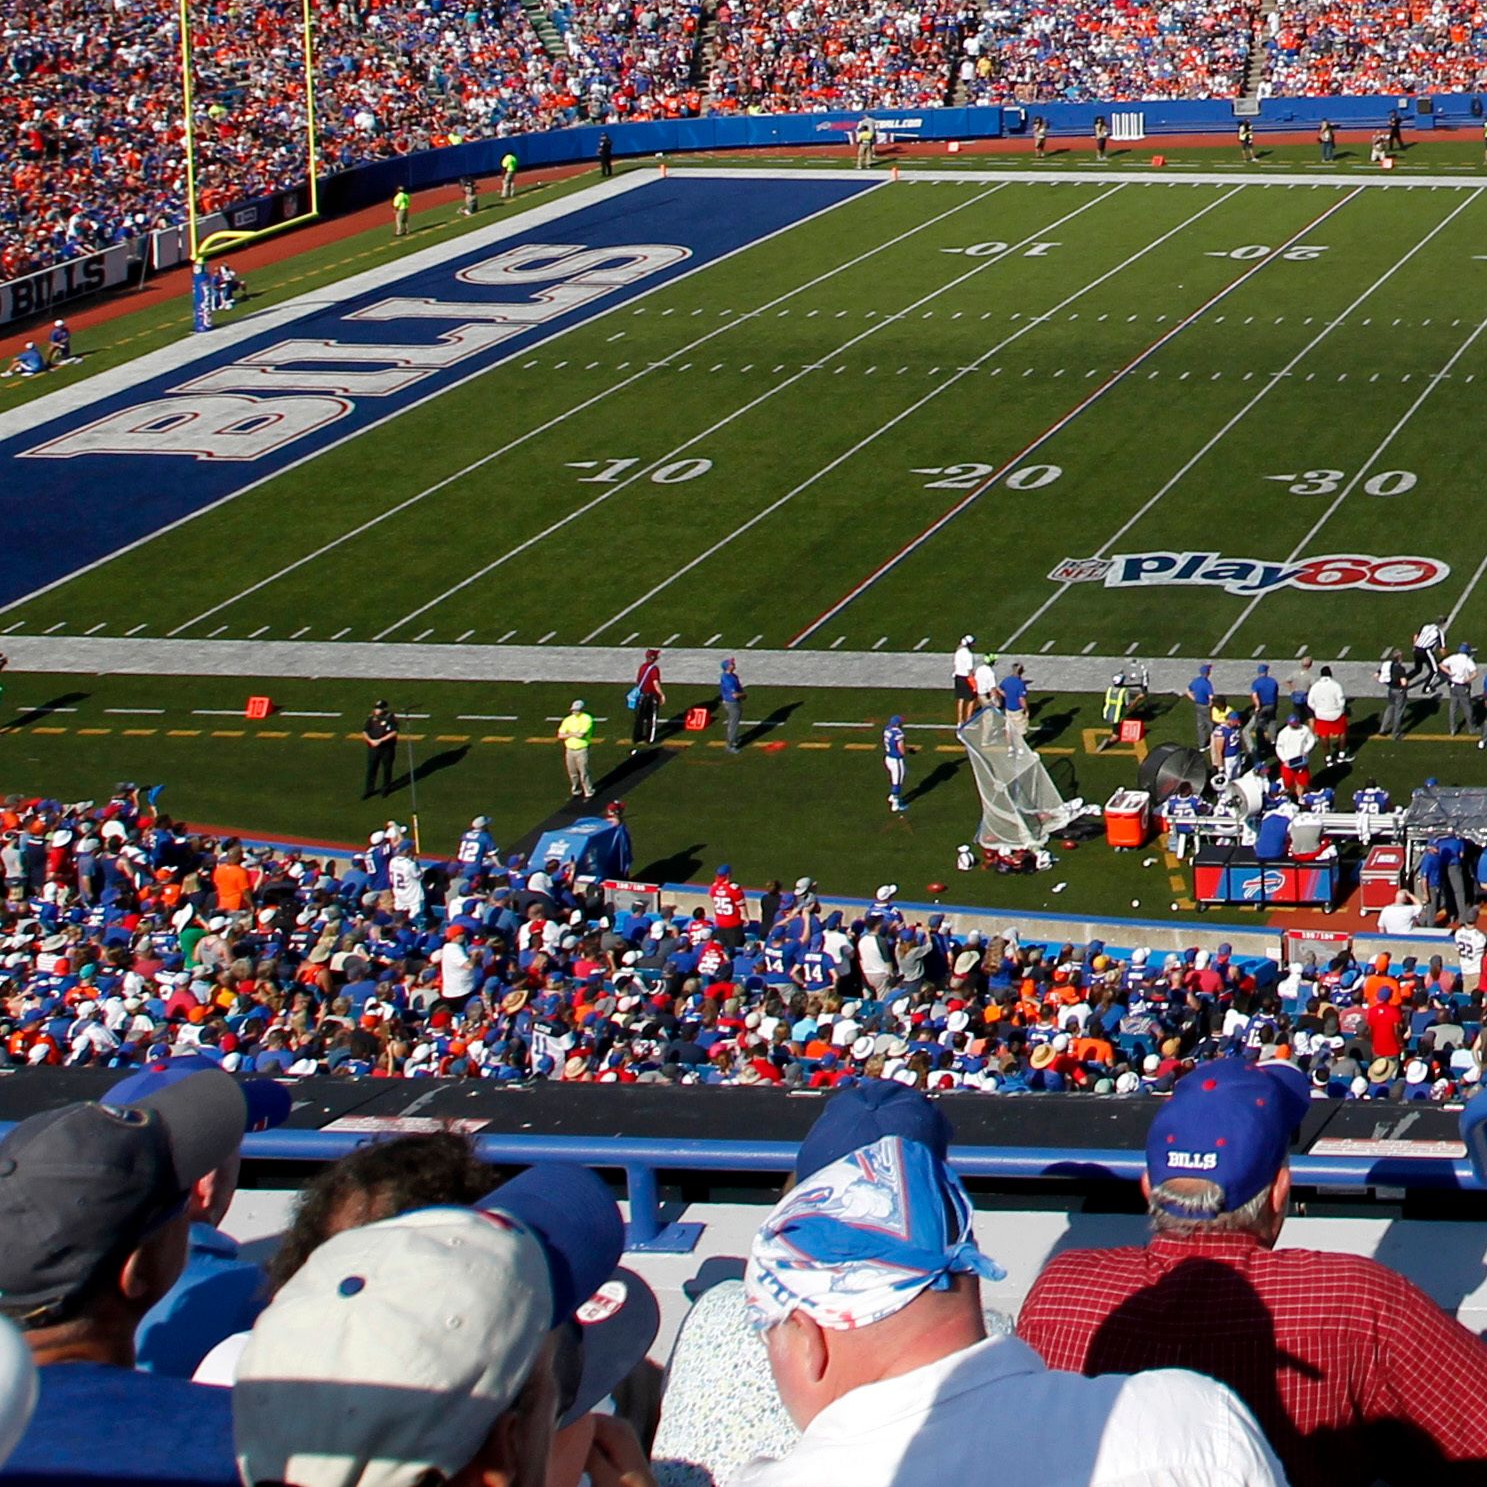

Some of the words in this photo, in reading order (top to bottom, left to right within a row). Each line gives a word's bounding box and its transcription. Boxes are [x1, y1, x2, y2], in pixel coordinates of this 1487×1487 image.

[11, 255, 107, 319] BILLS
[14, 244, 693, 462] BILLS
[577, 457, 713, 485] 10
[924, 463, 1062, 491] 20
[1290, 469, 1418, 496] 30
[1059, 568, 1099, 579] NFL
[459, 840, 480, 861] 12
[713, 897, 733, 915] 25
[765, 956, 785, 973] 14
[803, 964, 823, 982] 14
[1167, 1150, 1218, 1169] BILLS
